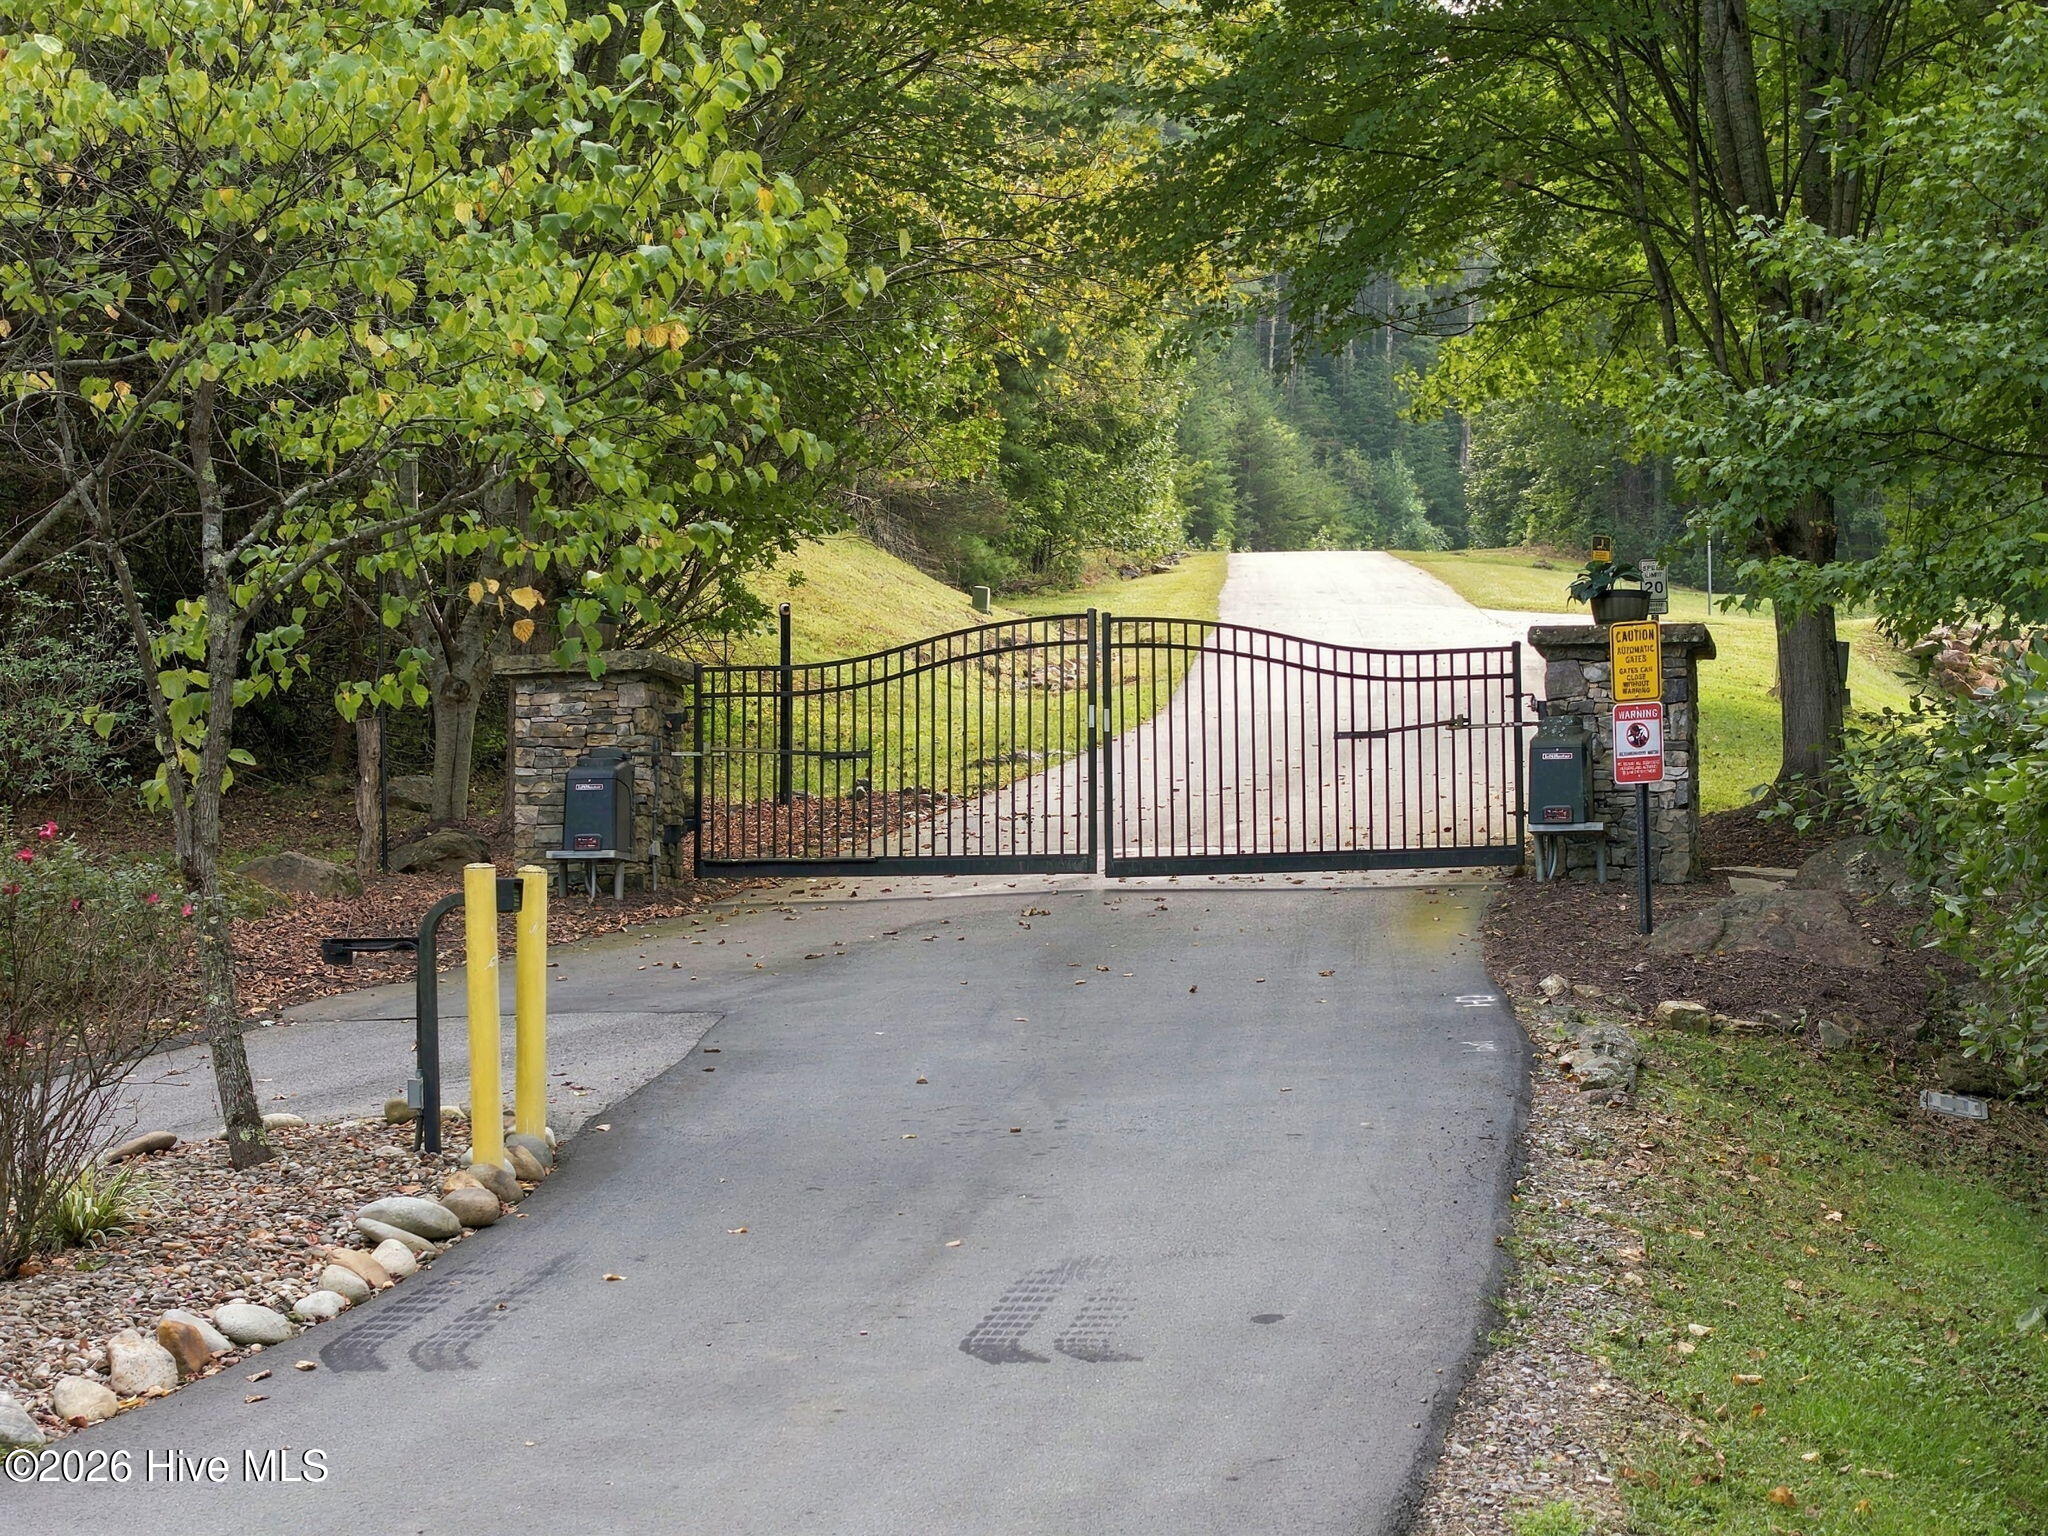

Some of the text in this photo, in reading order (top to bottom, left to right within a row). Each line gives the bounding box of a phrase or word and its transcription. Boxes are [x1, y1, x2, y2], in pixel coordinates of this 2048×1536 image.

[1645, 581, 1664, 593] 20
[1616, 629, 1655, 643] CAUTION
[1617, 645, 1655, 655] AUTOMATIC
[1625, 655, 1647, 664] GATES
[1619, 667, 1639, 675] GATES
[1623, 680, 1650, 688] WITHOUT
[1618, 709, 1658, 720] WARNING
